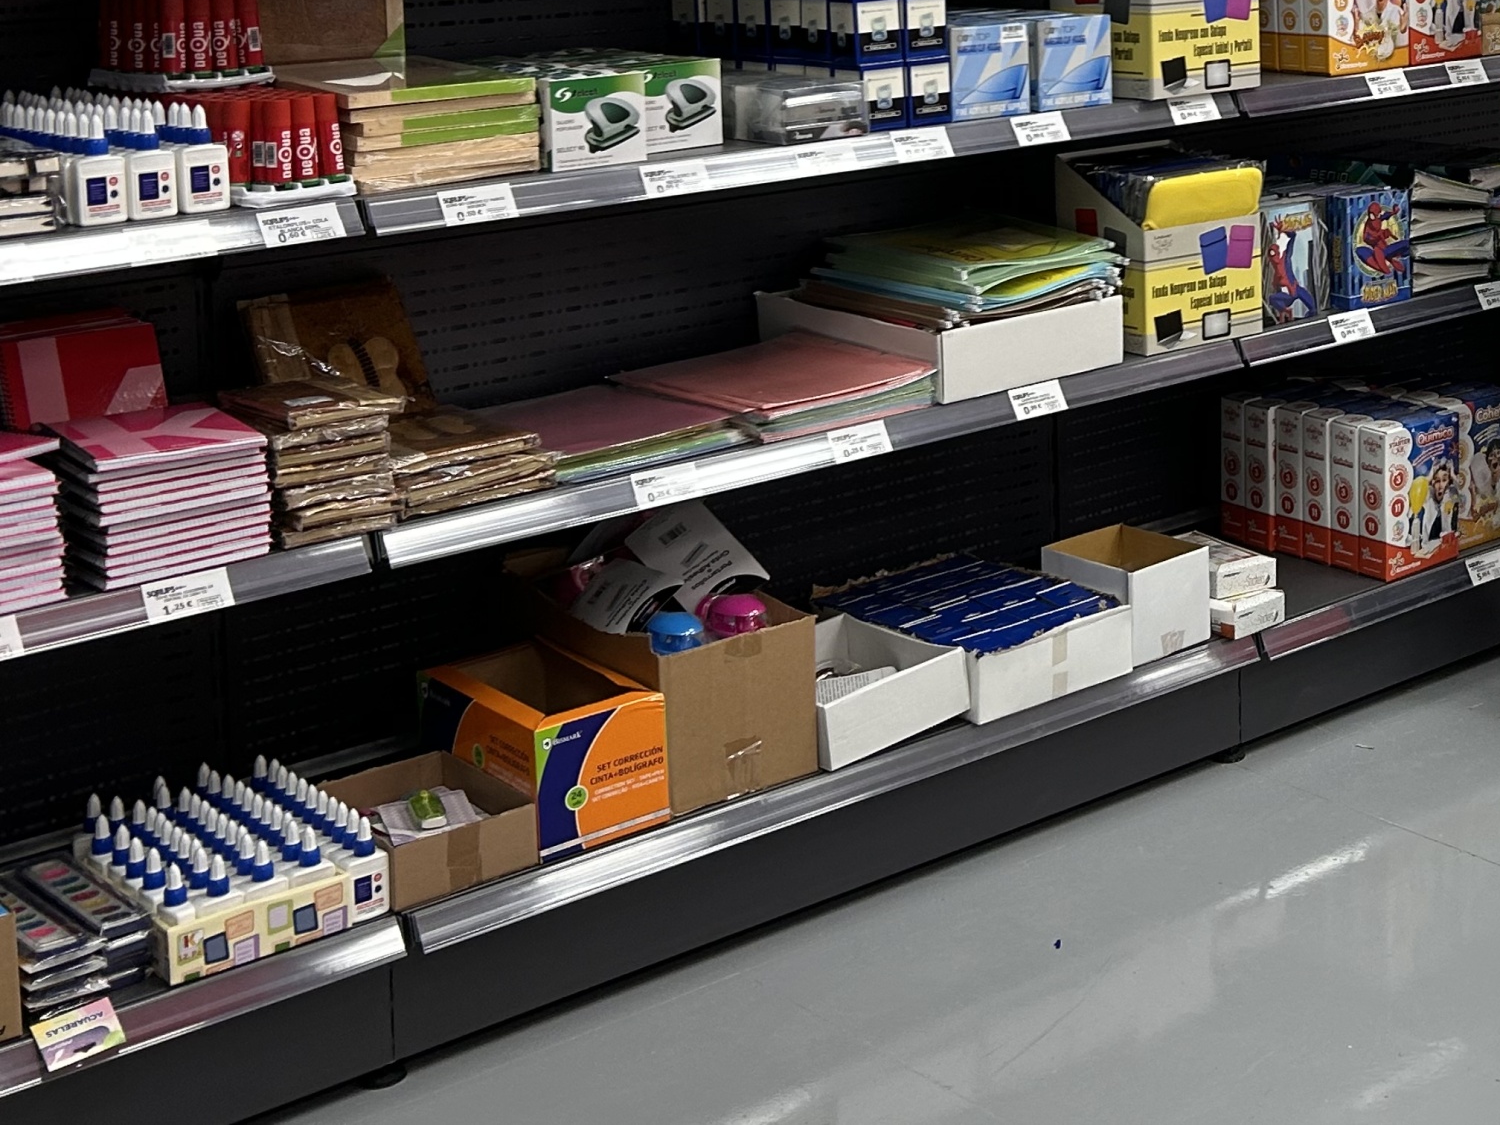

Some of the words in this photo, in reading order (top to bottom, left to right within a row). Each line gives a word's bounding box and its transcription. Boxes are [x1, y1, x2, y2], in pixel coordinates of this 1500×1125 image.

[1152, 285, 1169, 299] Funda
[1169, 280, 1197, 296] Neopreno
[1197, 280, 1208, 290] con
[1208, 274, 1227, 289] Solapa
[1190, 294, 1213, 311] Especial
[1417, 427, 1454, 444] Químico
[162, 603, 187, 616] 1.25
[596, 762, 611, 773] SET
[613, 746, 664, 768] CORRECCIÓN
[590, 757, 665, 786] CINTA+BOLÍGRAFO
[571, 789, 582, 800] 24
[45, 1011, 104, 1038] ACUARELAS
